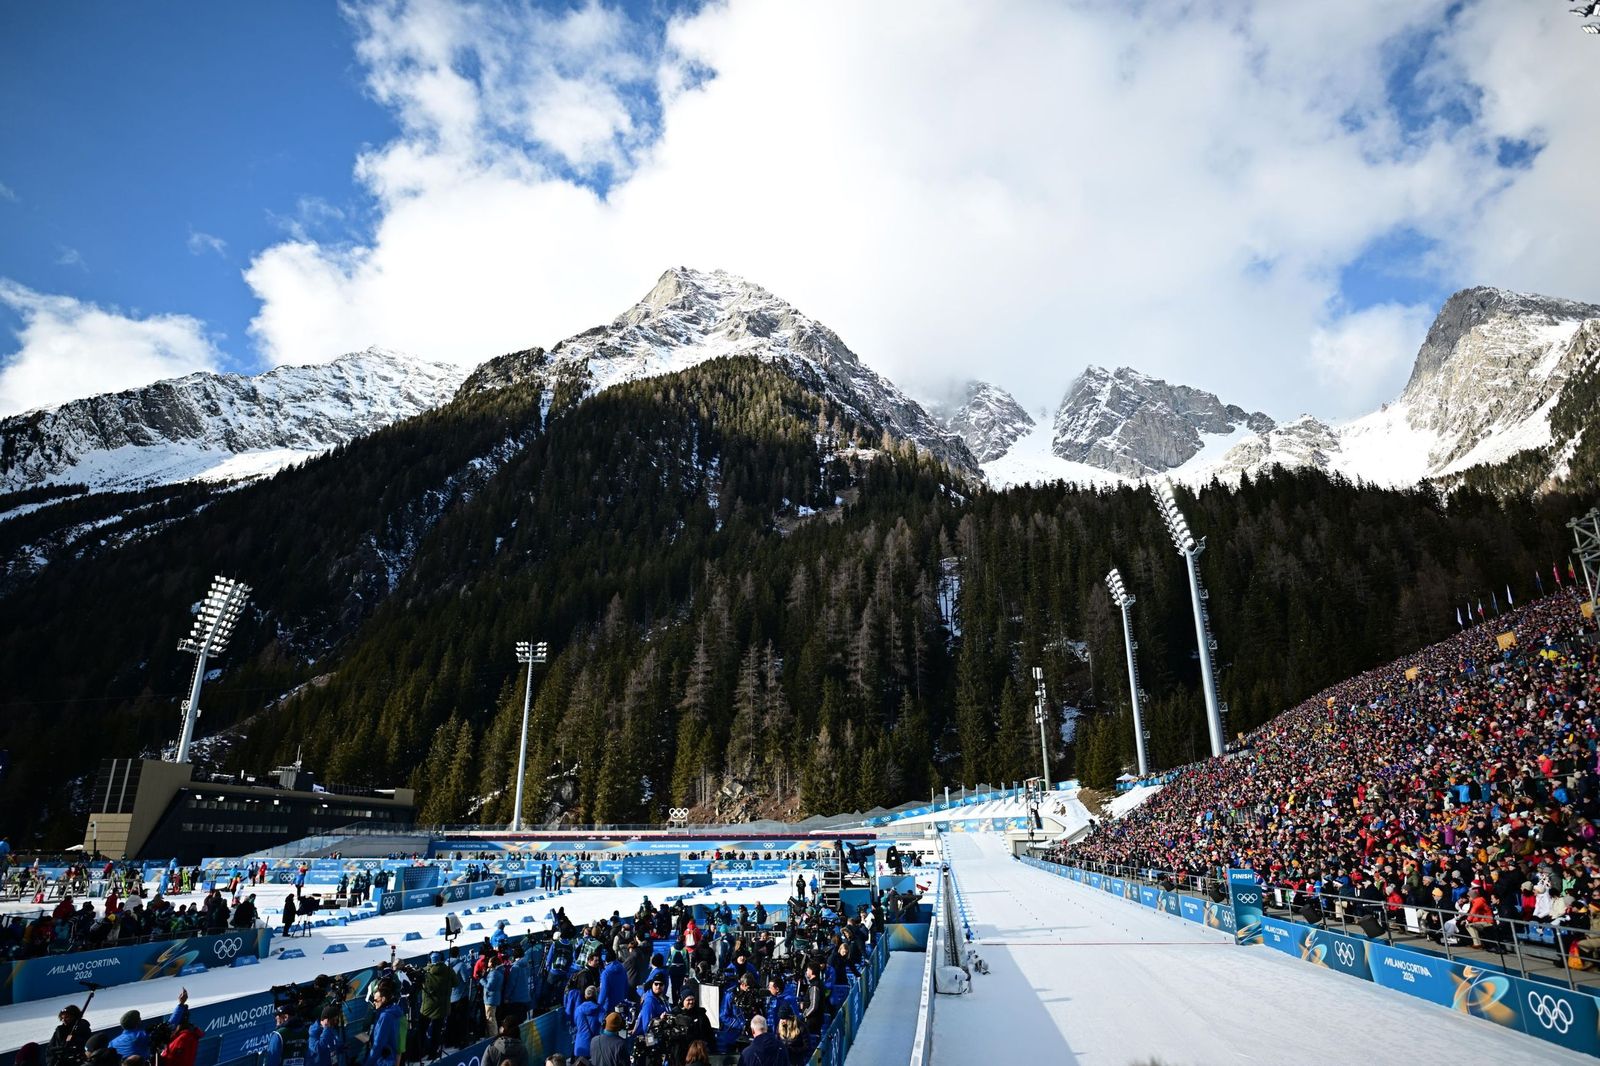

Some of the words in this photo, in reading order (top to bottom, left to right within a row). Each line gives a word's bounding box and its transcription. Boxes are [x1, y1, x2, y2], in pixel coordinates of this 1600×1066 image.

[47, 962, 85, 976] MILANO
[85, 957, 120, 969] CORTINA
[1384, 957, 1406, 970] MILANO
[74, 970, 92, 980] 2026
[205, 1010, 248, 1032] MILANO
[249, 1003, 276, 1018] CORTI
[240, 1032, 272, 1051] MILAN
